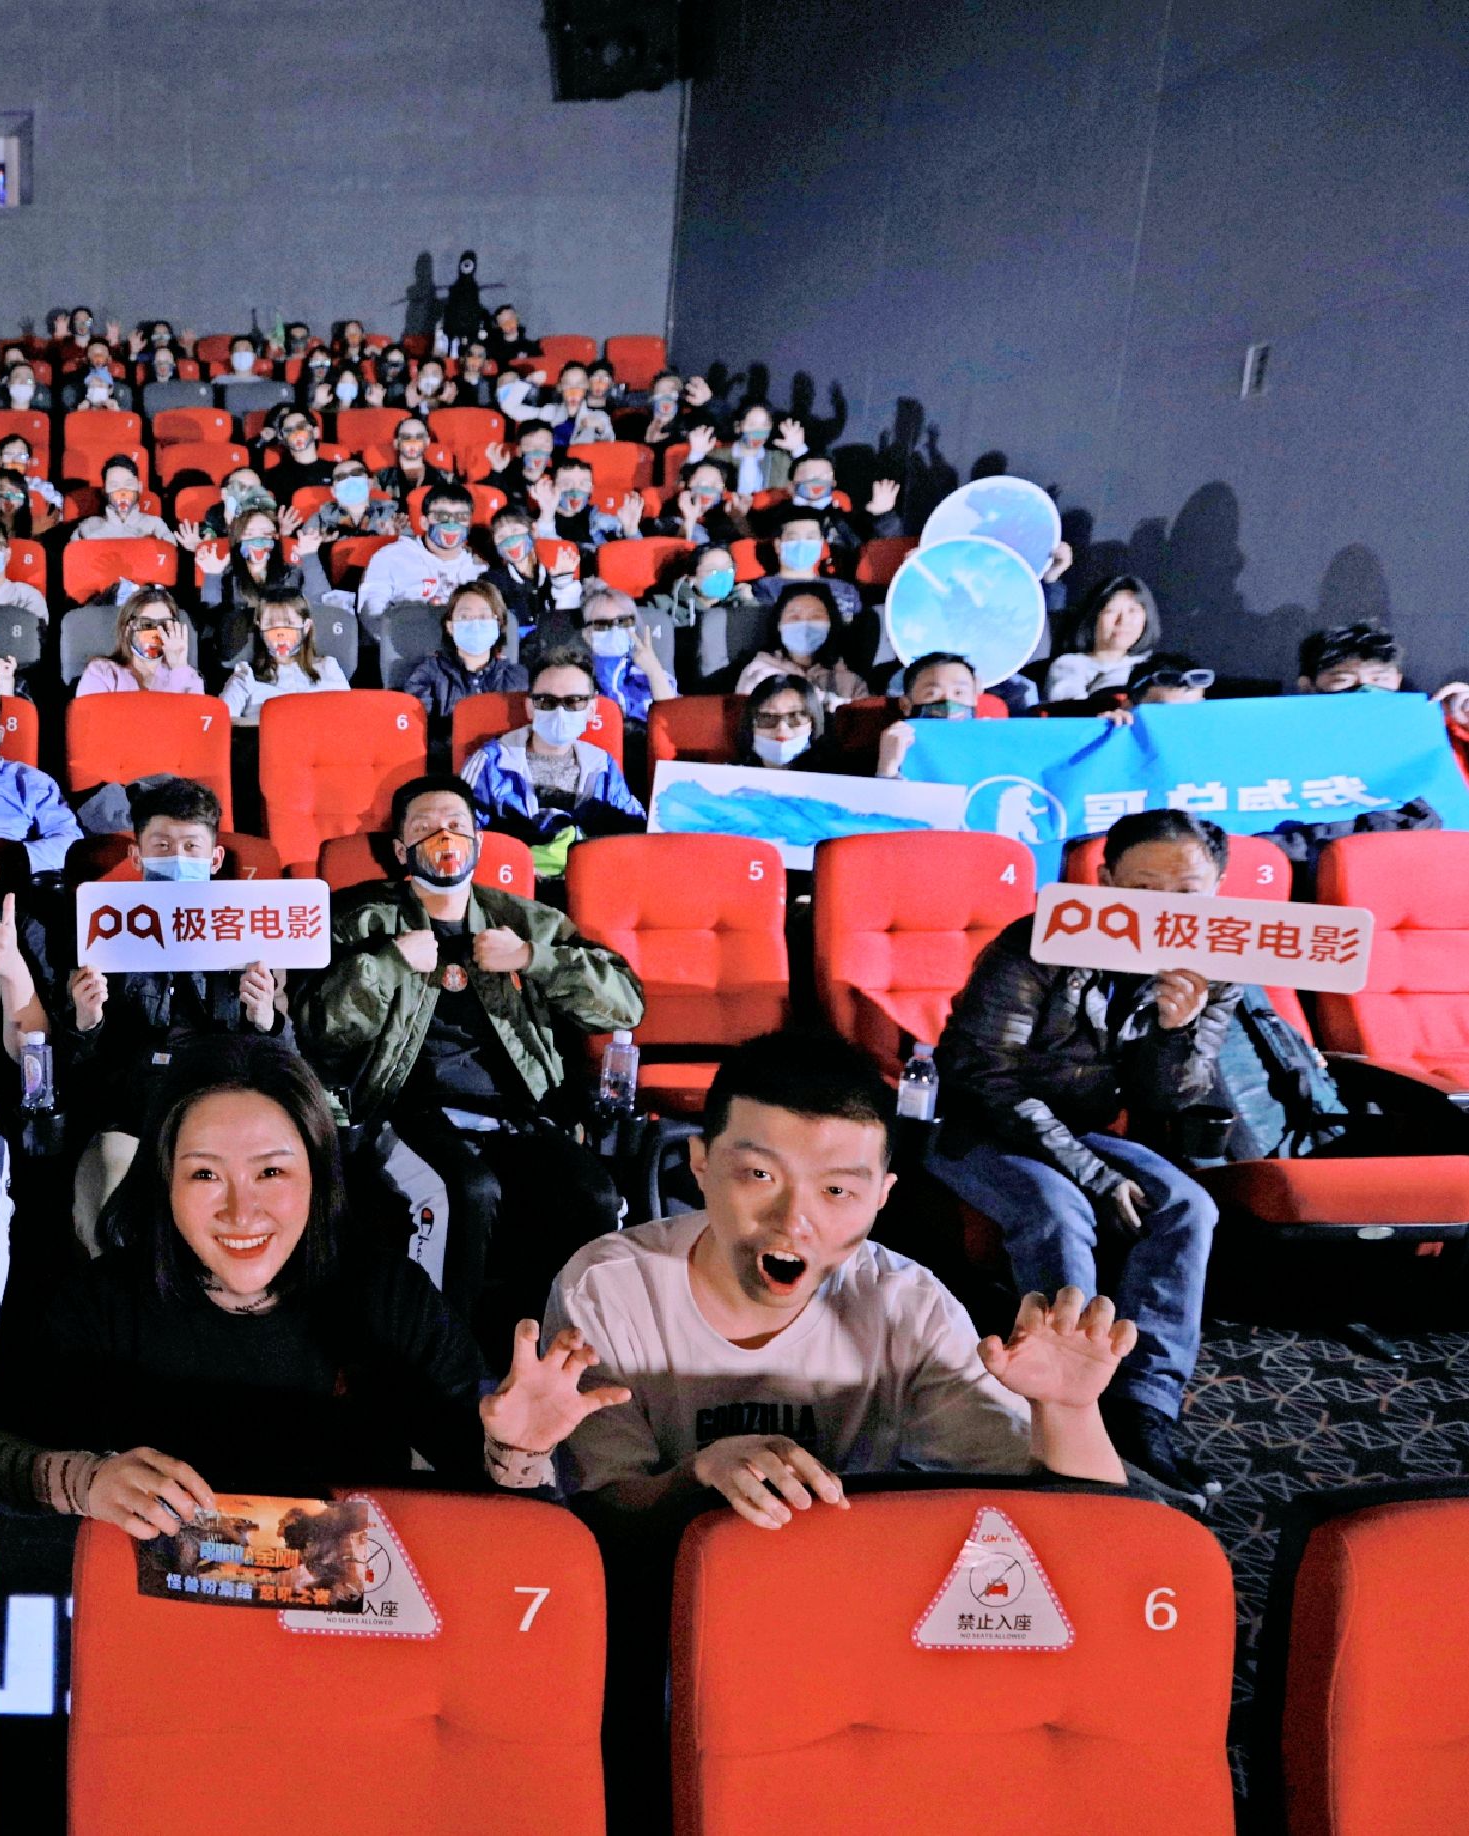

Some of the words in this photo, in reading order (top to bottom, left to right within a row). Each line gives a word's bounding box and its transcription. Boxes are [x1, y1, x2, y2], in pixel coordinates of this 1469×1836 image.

[156, 554, 167, 565] 7
[12, 625, 22, 637] 8
[332, 622, 343, 635] 6
[6, 717, 18, 731] 8
[201, 715, 213, 731] 7
[397, 714, 408, 730] 6
[592, 715, 603, 731] 5
[498, 864, 513, 883] 6
[748, 861, 764, 880] 5
[999, 863, 1017, 885] 4
[1256, 864, 1274, 884] 3
[172, 905, 321, 942] 极客电影
[1153, 910, 1359, 963] 极客电影
[514, 1586, 550, 1631] 7
[1145, 1587, 1178, 1631] 6
[957, 1613, 1032, 1631] 禁止入座
